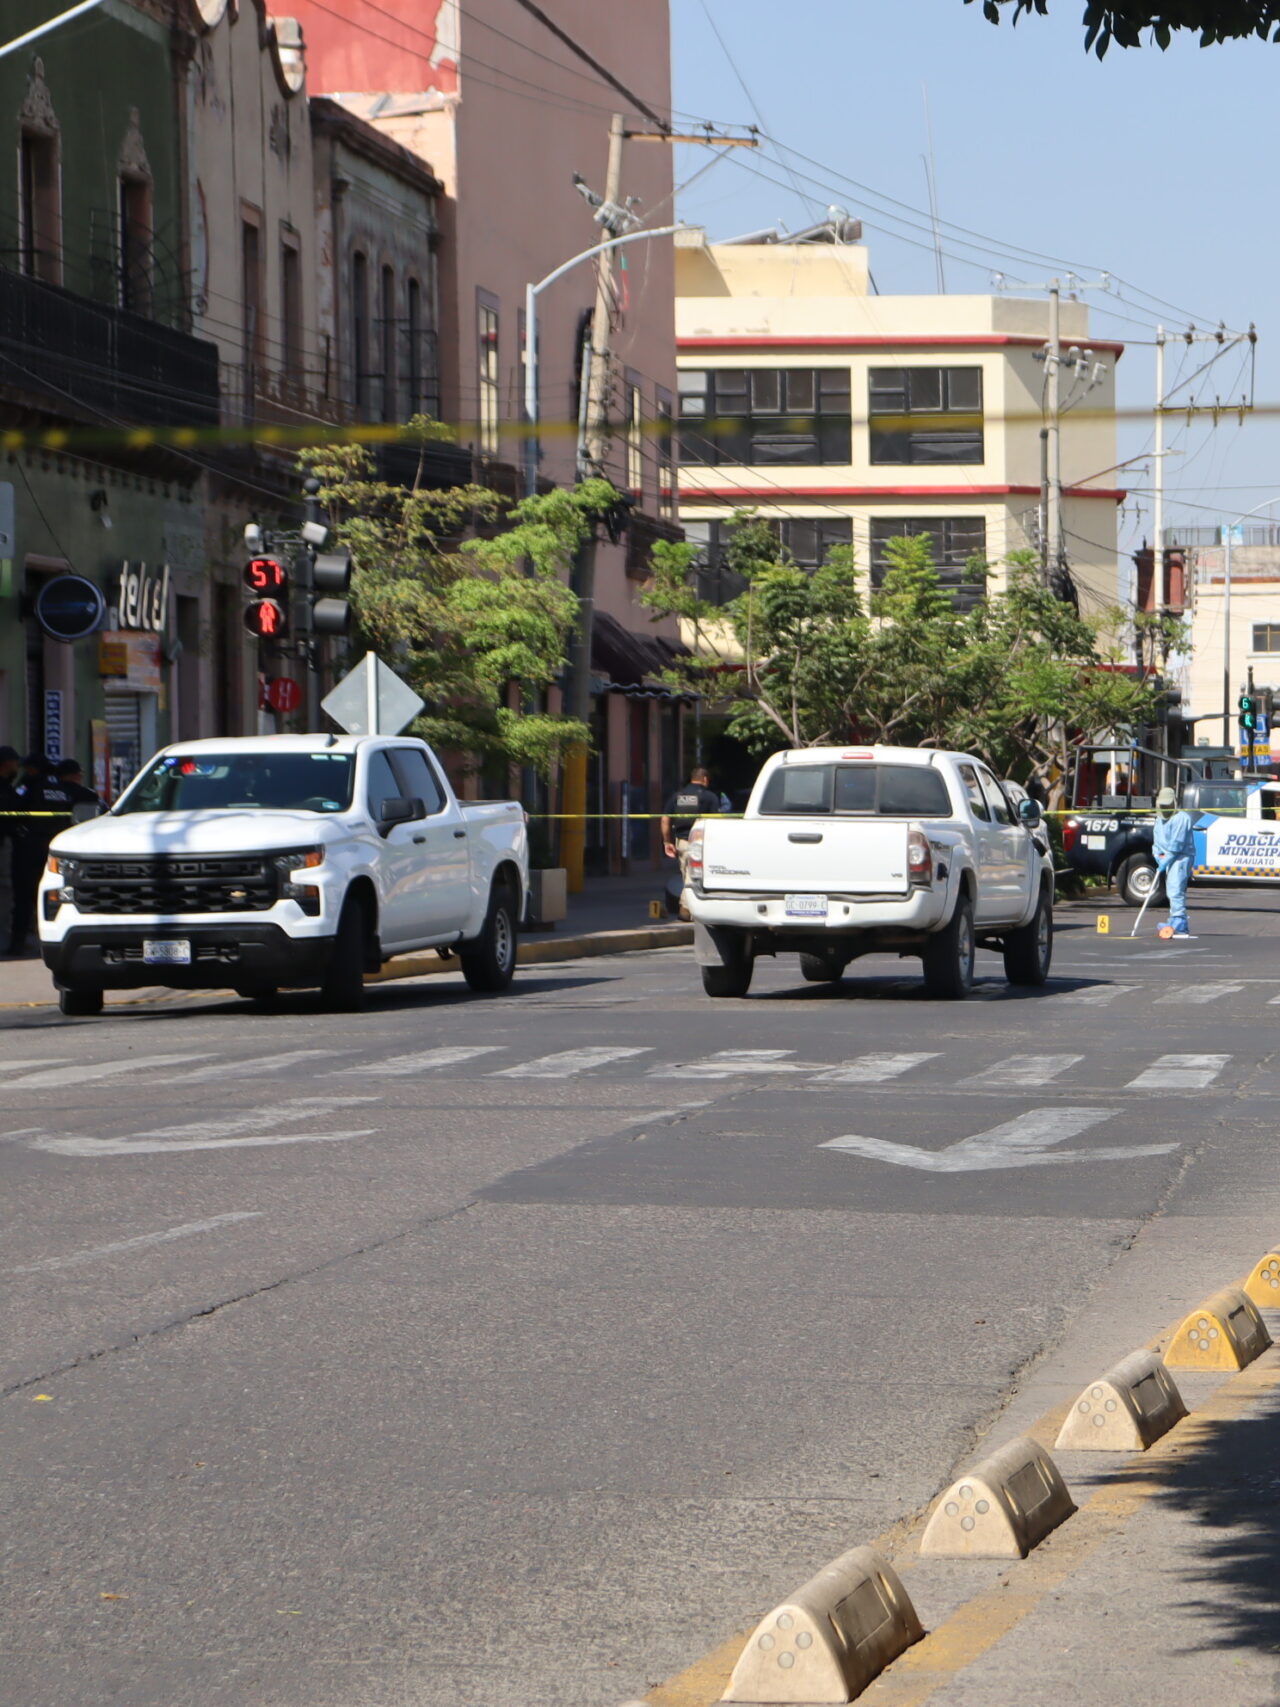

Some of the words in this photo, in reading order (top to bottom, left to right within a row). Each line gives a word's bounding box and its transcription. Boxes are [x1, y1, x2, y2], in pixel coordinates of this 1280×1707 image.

[252, 560, 282, 587] 57
[119, 560, 170, 631] telcel
[1242, 697, 1249, 710] 6
[1240, 745, 1270, 754] RTAS
[1085, 819, 1119, 832] 1679
[1099, 917, 1107, 929] 6
